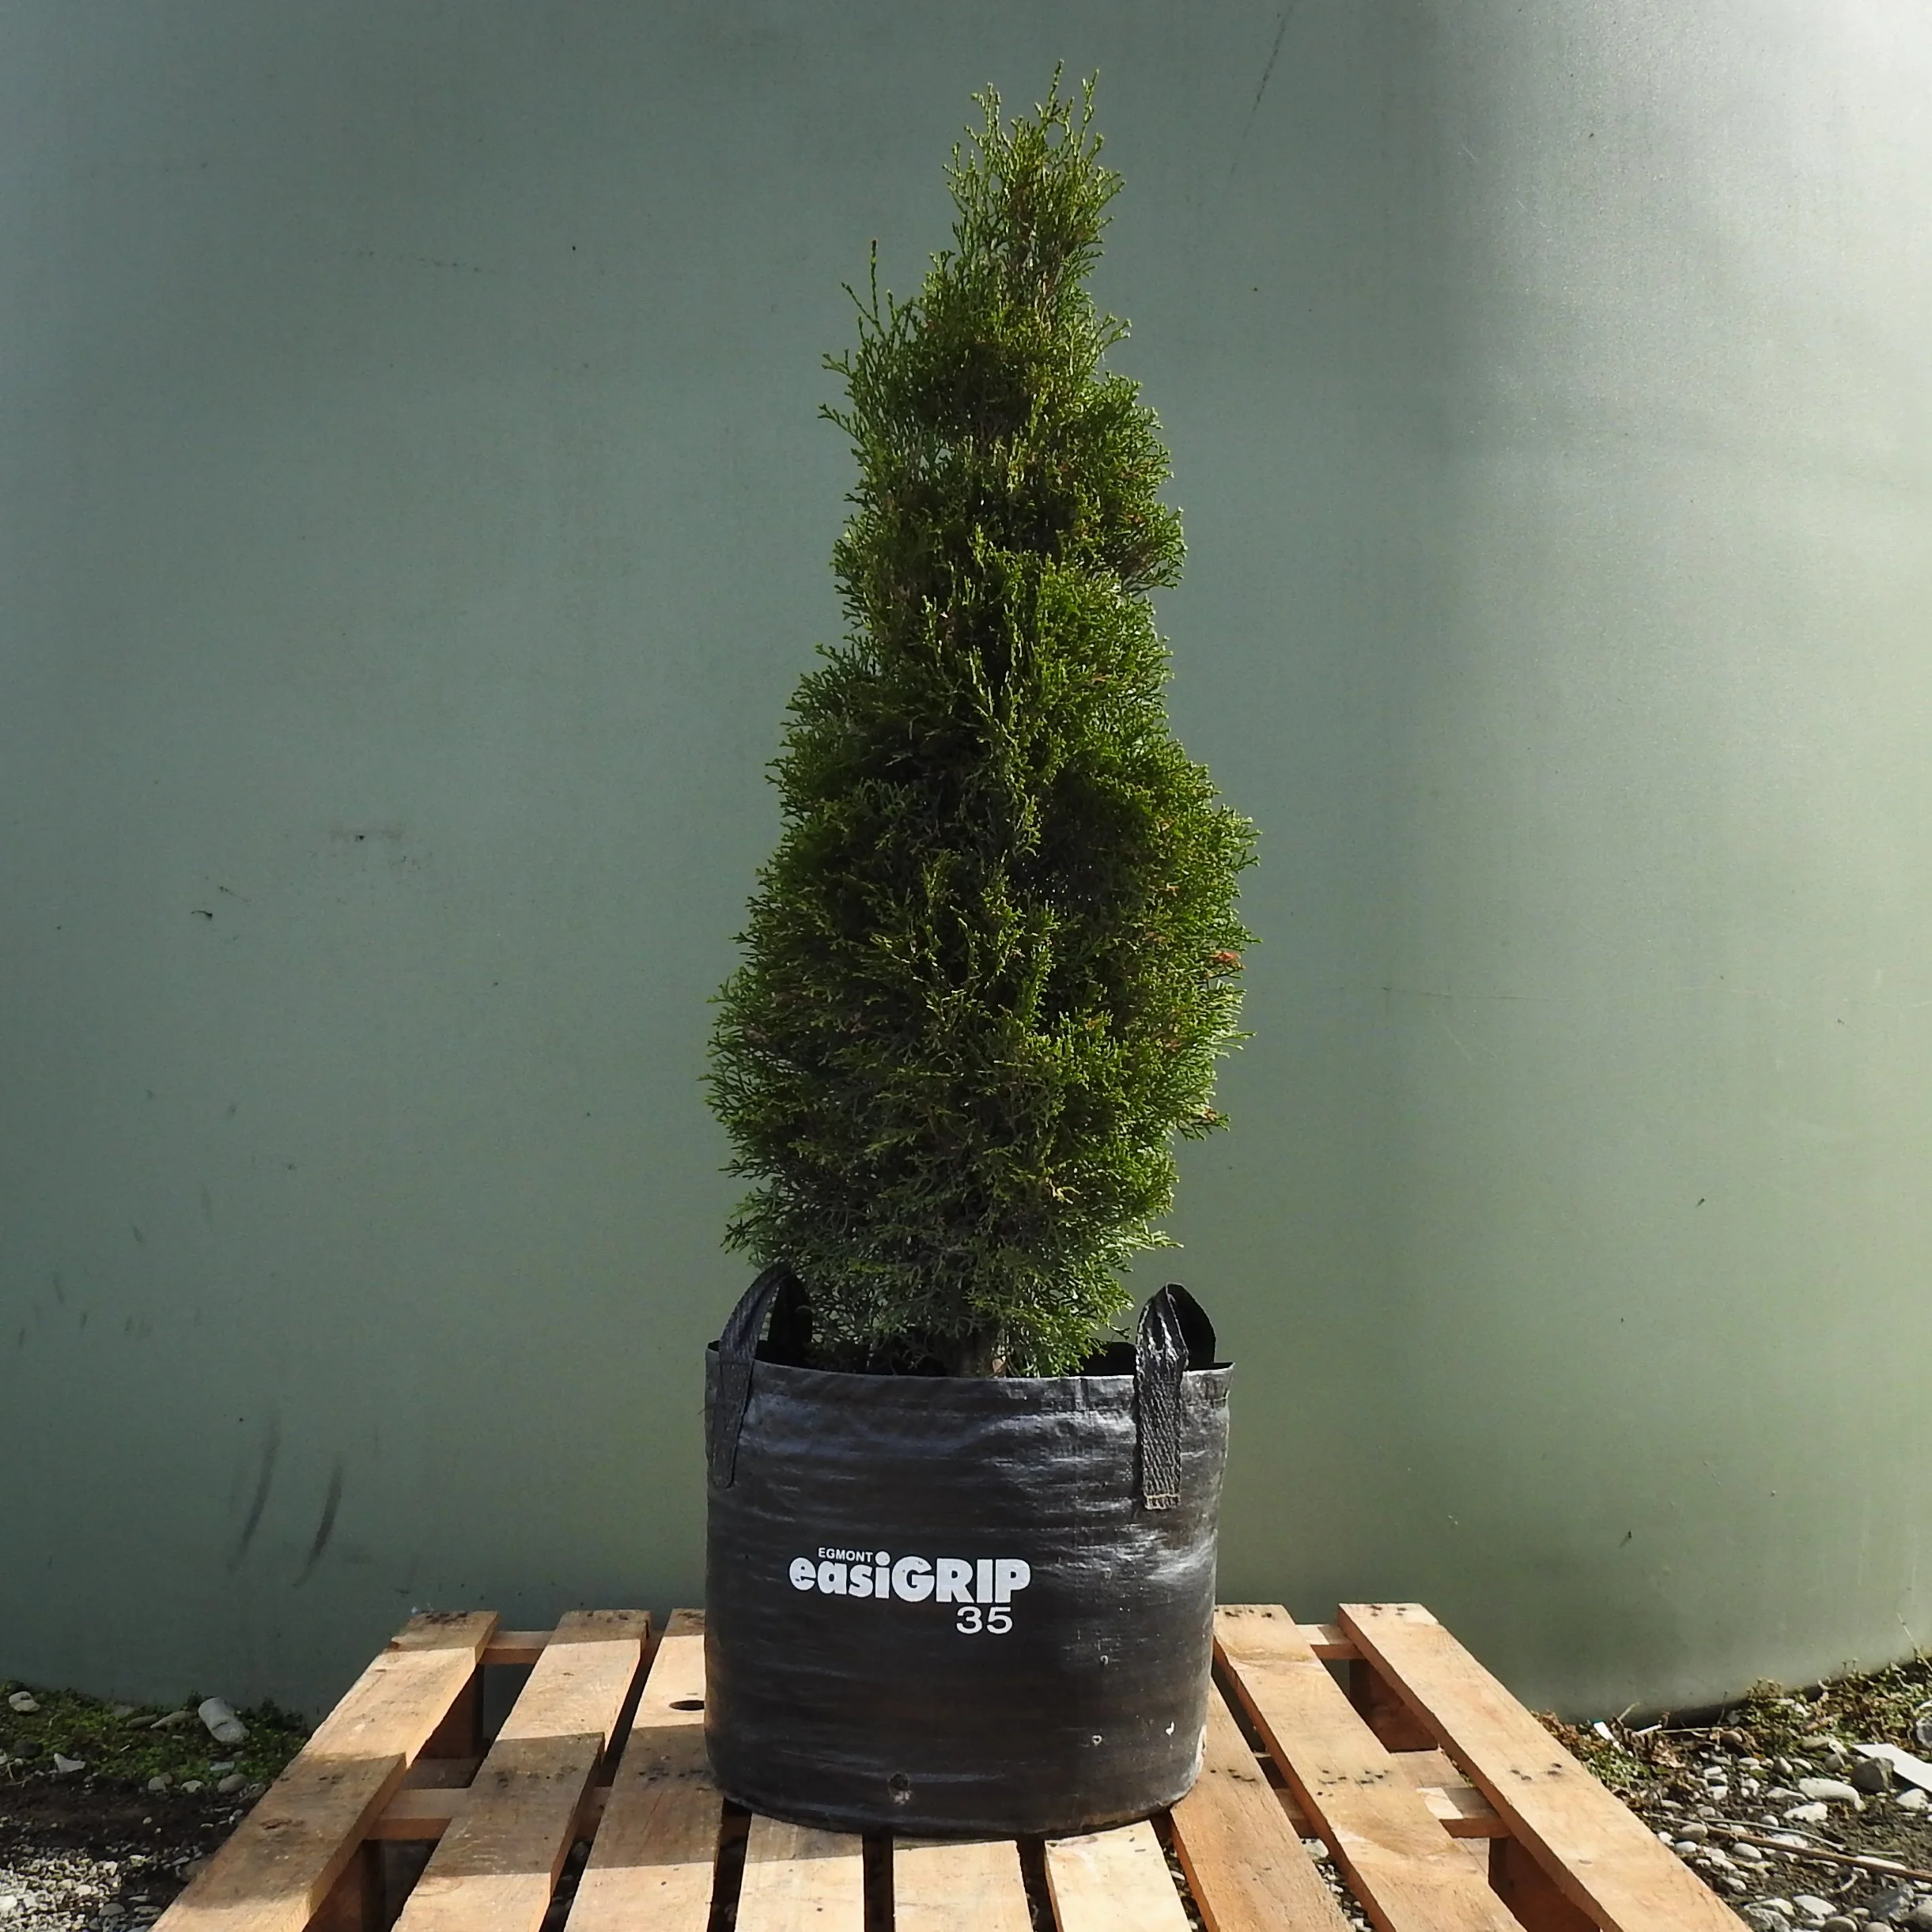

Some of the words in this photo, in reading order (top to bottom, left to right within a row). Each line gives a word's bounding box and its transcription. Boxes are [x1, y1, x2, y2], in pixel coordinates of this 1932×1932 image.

[818, 1547, 873, 1563] EGMONT
[789, 1551, 1031, 1604] easiGRIP
[956, 1605, 1013, 1634] 35
